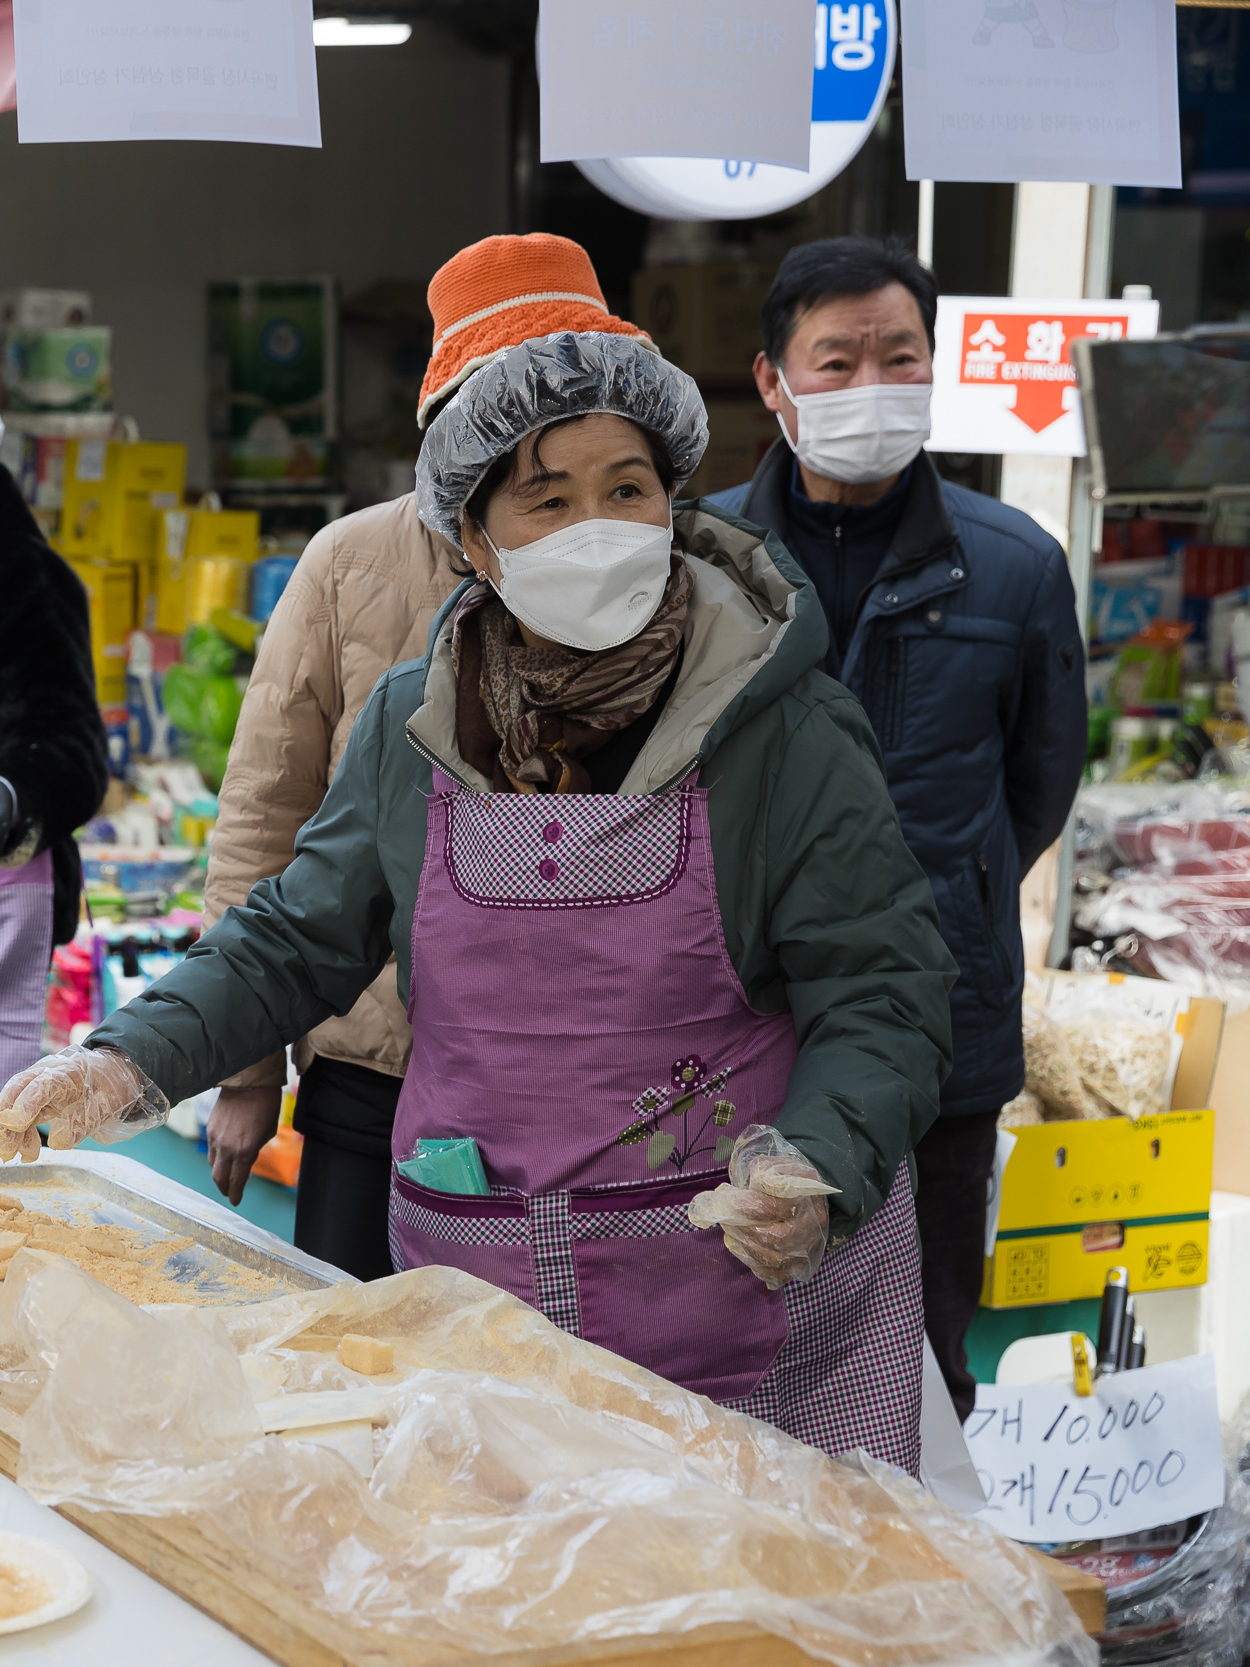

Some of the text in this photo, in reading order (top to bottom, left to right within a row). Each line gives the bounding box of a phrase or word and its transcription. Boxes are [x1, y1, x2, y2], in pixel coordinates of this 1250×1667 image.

[815, 3, 882, 71] 방
[964, 361, 997, 380] FIRE
[1042, 1390, 1165, 1446] 10.000
[1046, 1449, 1186, 1526] 15.000
